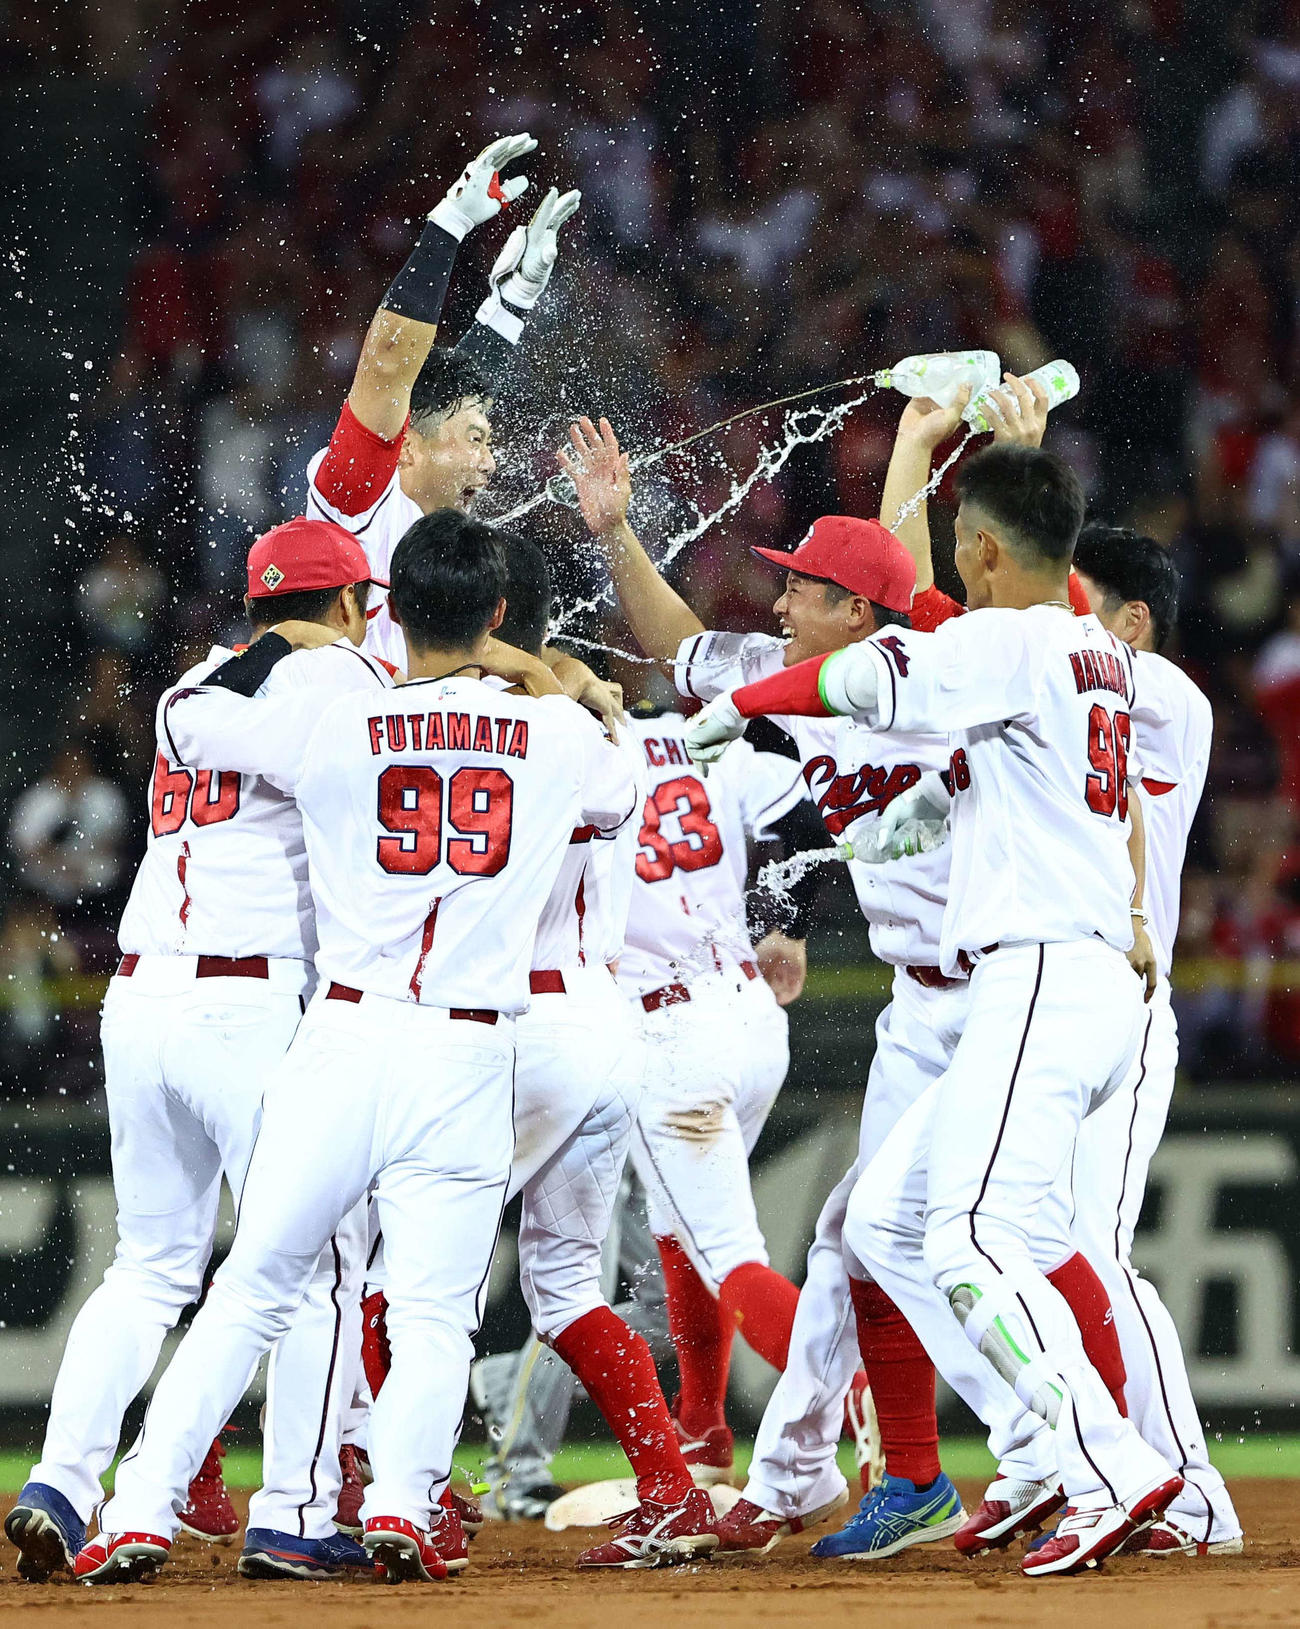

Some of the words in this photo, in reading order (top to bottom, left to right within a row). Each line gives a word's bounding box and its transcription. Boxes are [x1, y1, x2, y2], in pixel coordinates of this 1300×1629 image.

[368, 712, 528, 760] FUTAMATA
[1084, 703, 1130, 823] 96
[377, 765, 514, 877] 99
[802, 755, 921, 836] Carp
